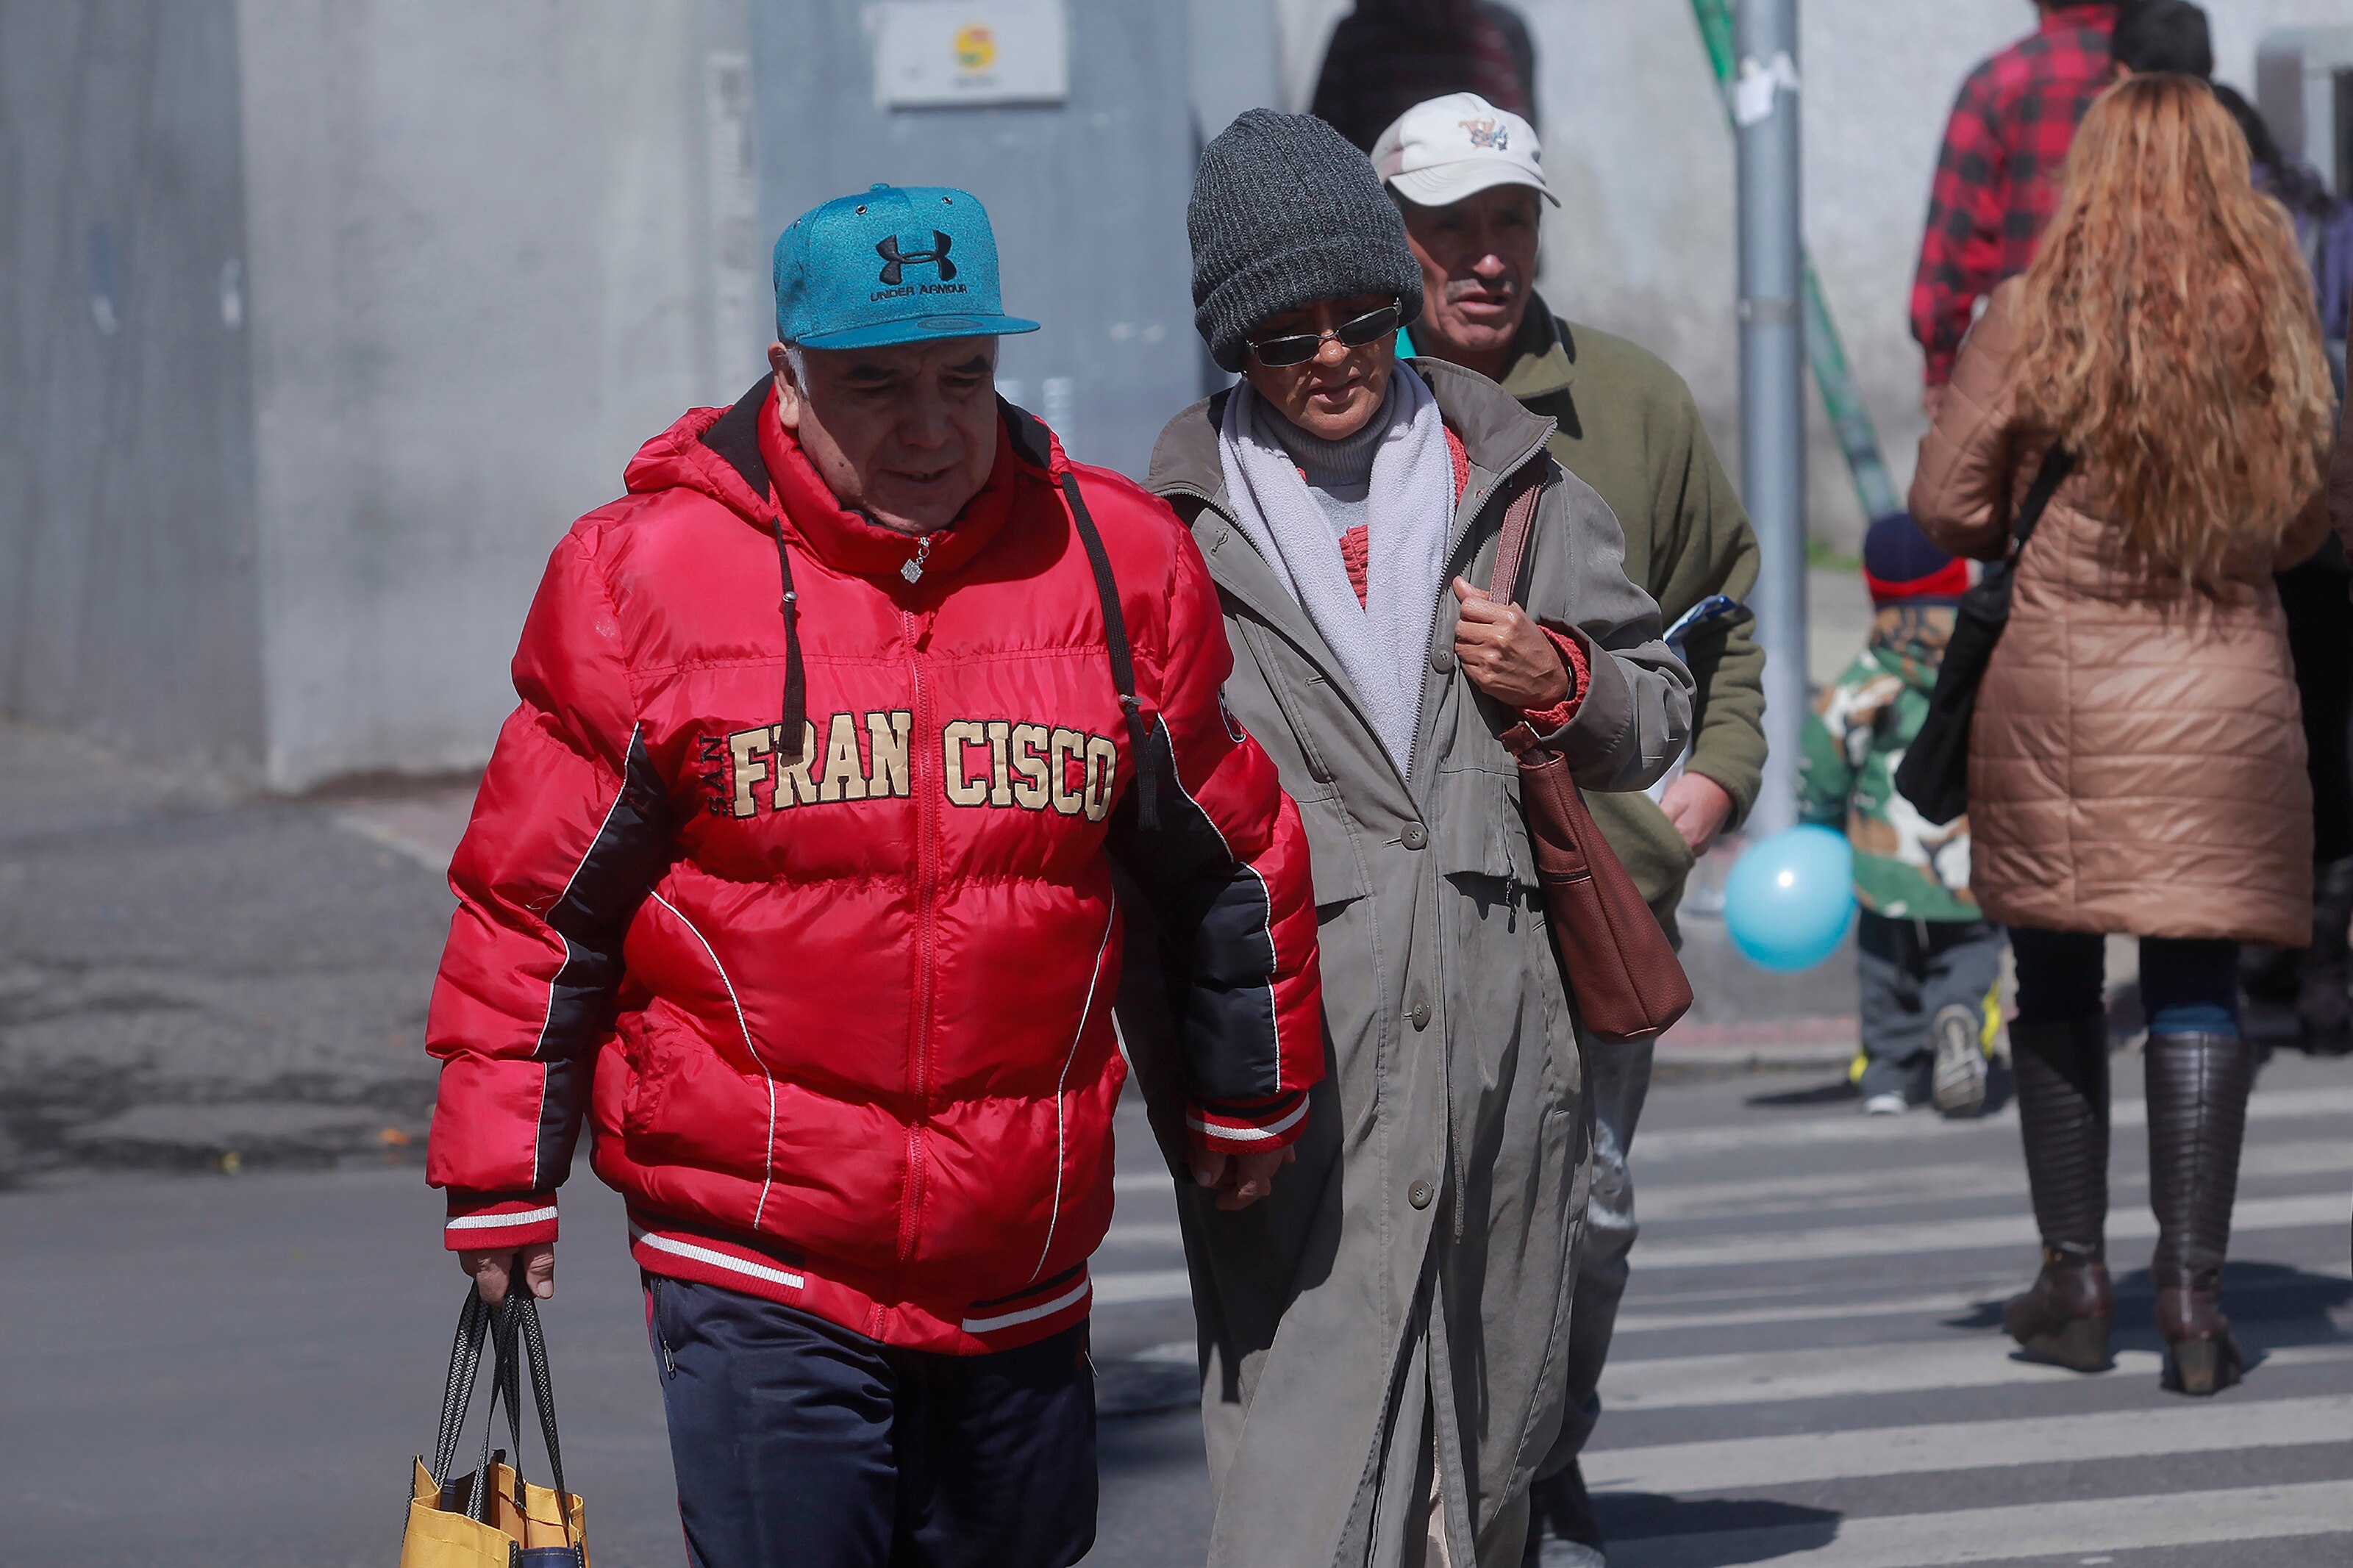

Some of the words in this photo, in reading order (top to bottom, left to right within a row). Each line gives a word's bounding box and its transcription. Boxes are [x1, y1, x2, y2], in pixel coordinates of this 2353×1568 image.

[870, 286, 915, 301] UNDER
[920, 284, 968, 295] ARMOUR
[699, 734, 728, 817] SAN
[942, 718, 1117, 823] CISCO
